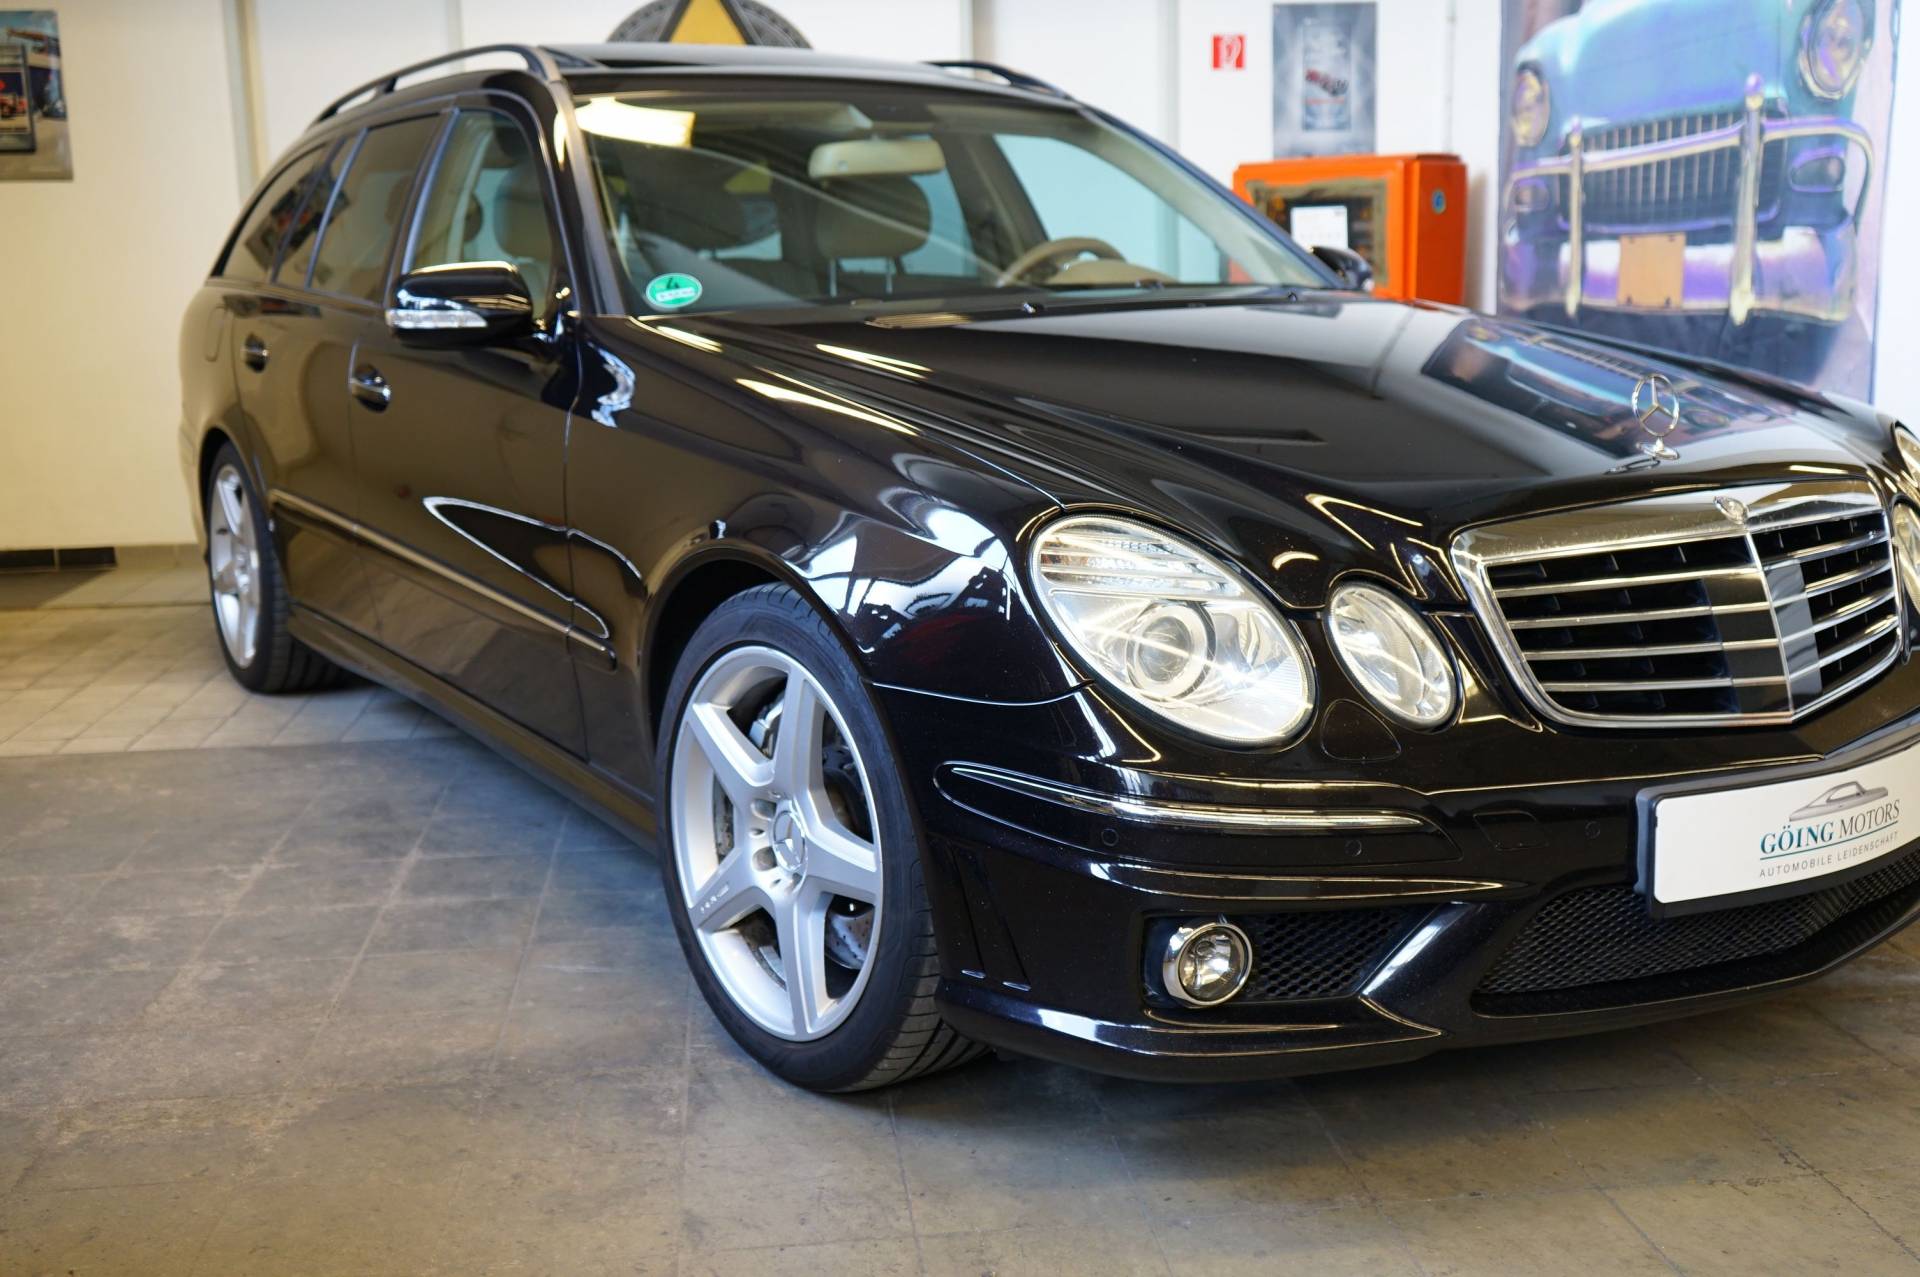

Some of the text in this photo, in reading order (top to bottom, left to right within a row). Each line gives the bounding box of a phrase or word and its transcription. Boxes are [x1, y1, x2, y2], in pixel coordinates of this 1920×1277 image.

[1760, 799, 1900, 855] GÖING MOTORS
[1760, 831, 1898, 877] AUTOMOBILE LEIDENSCHAFT
